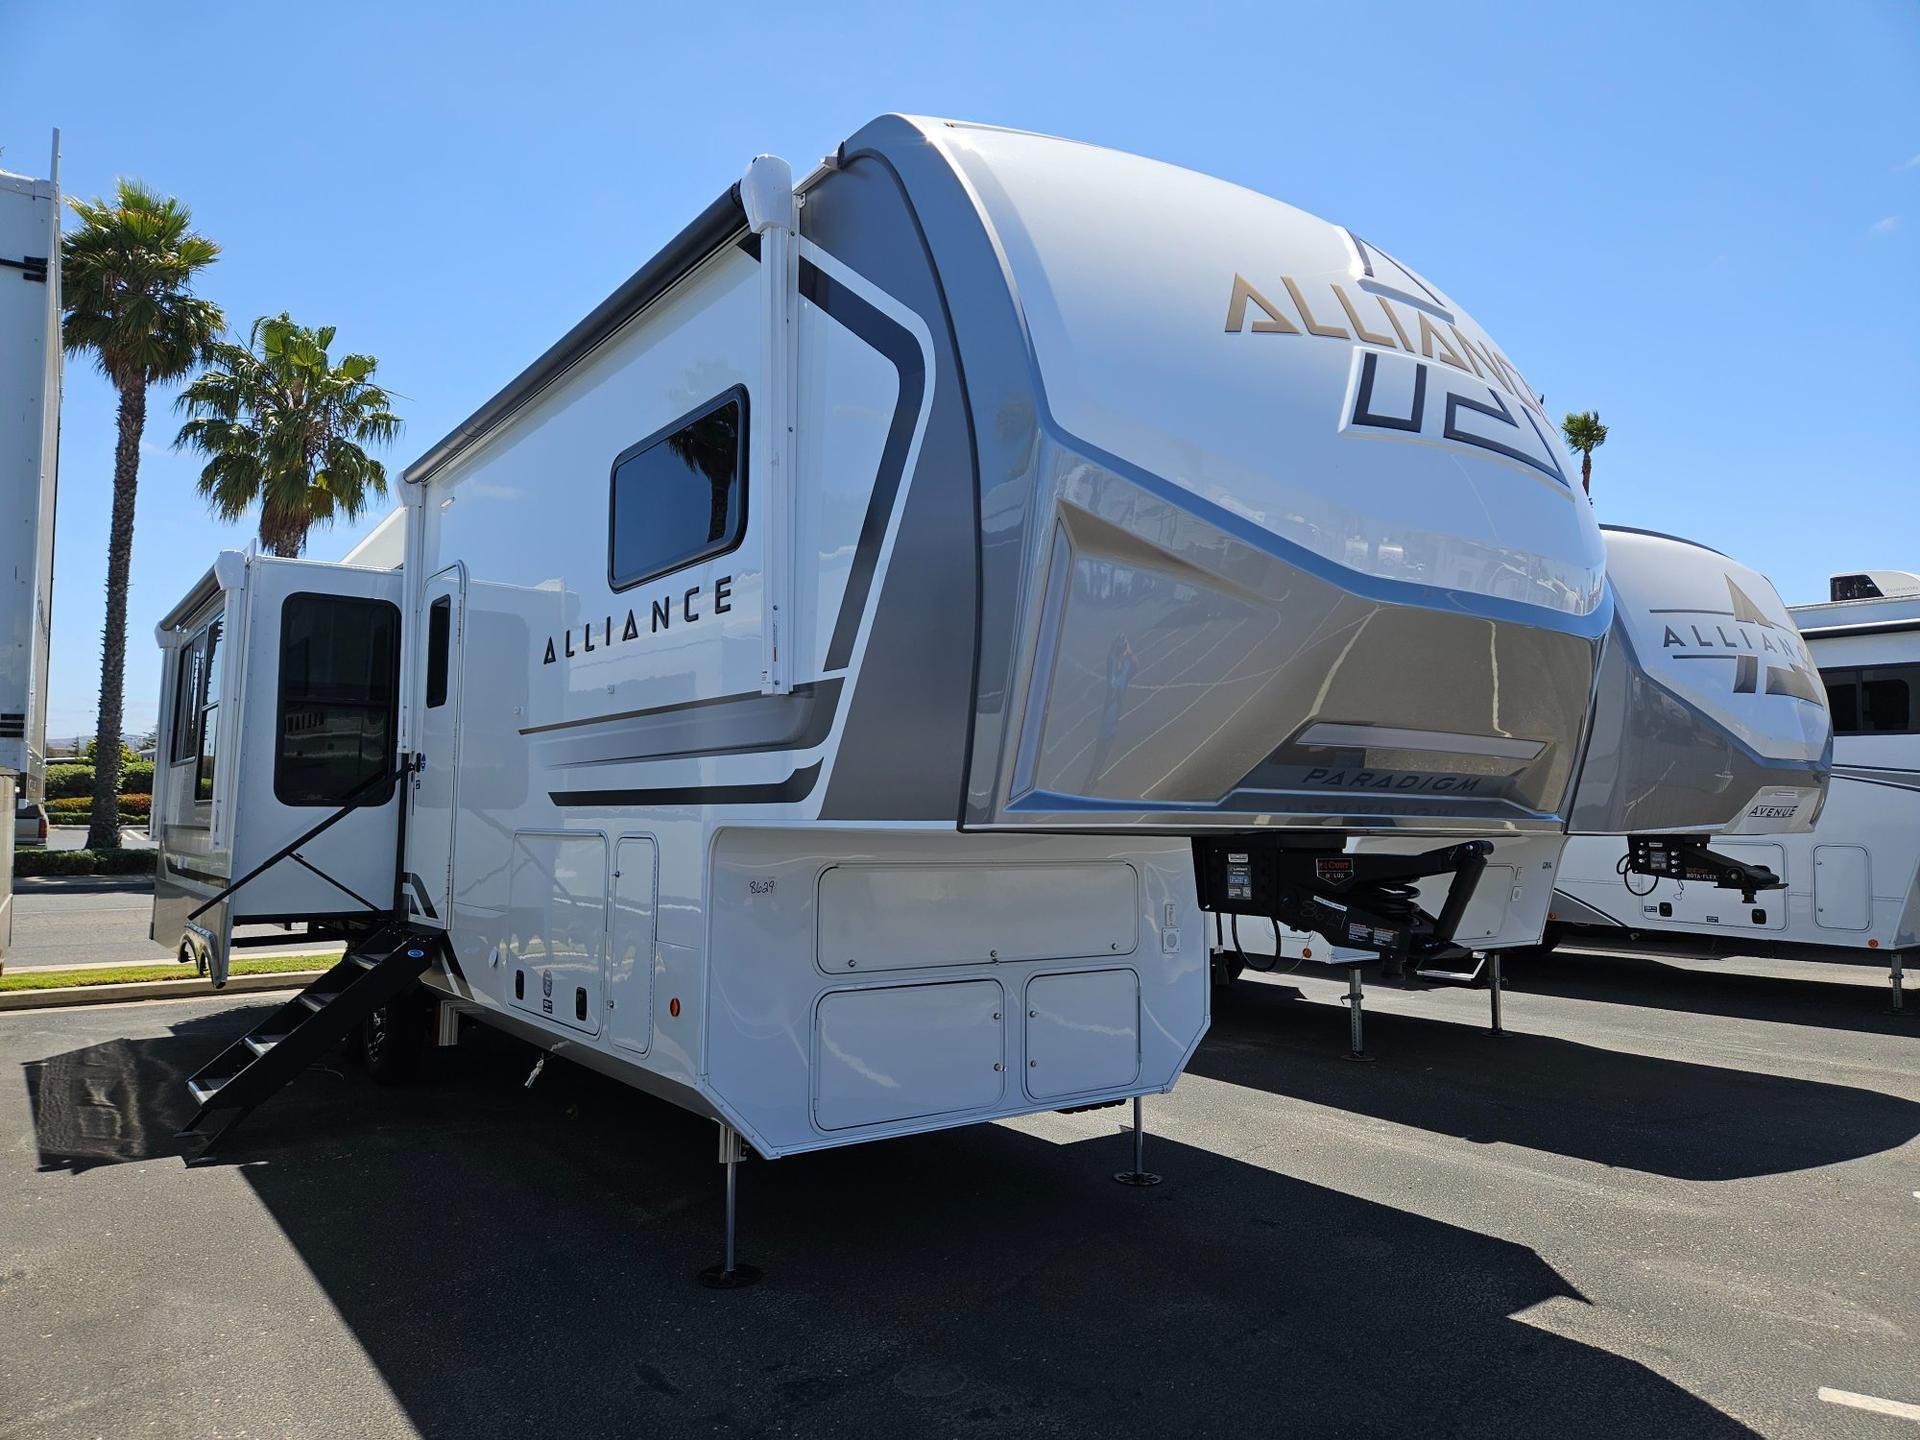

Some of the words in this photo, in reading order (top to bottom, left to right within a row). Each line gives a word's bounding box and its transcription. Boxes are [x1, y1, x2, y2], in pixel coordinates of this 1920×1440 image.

[543, 575, 732, 665] ALLIANCE
[1302, 768, 1482, 792] PARADIGM
[1749, 804, 1798, 817] AVENUE
[749, 880, 774, 894] 8629
